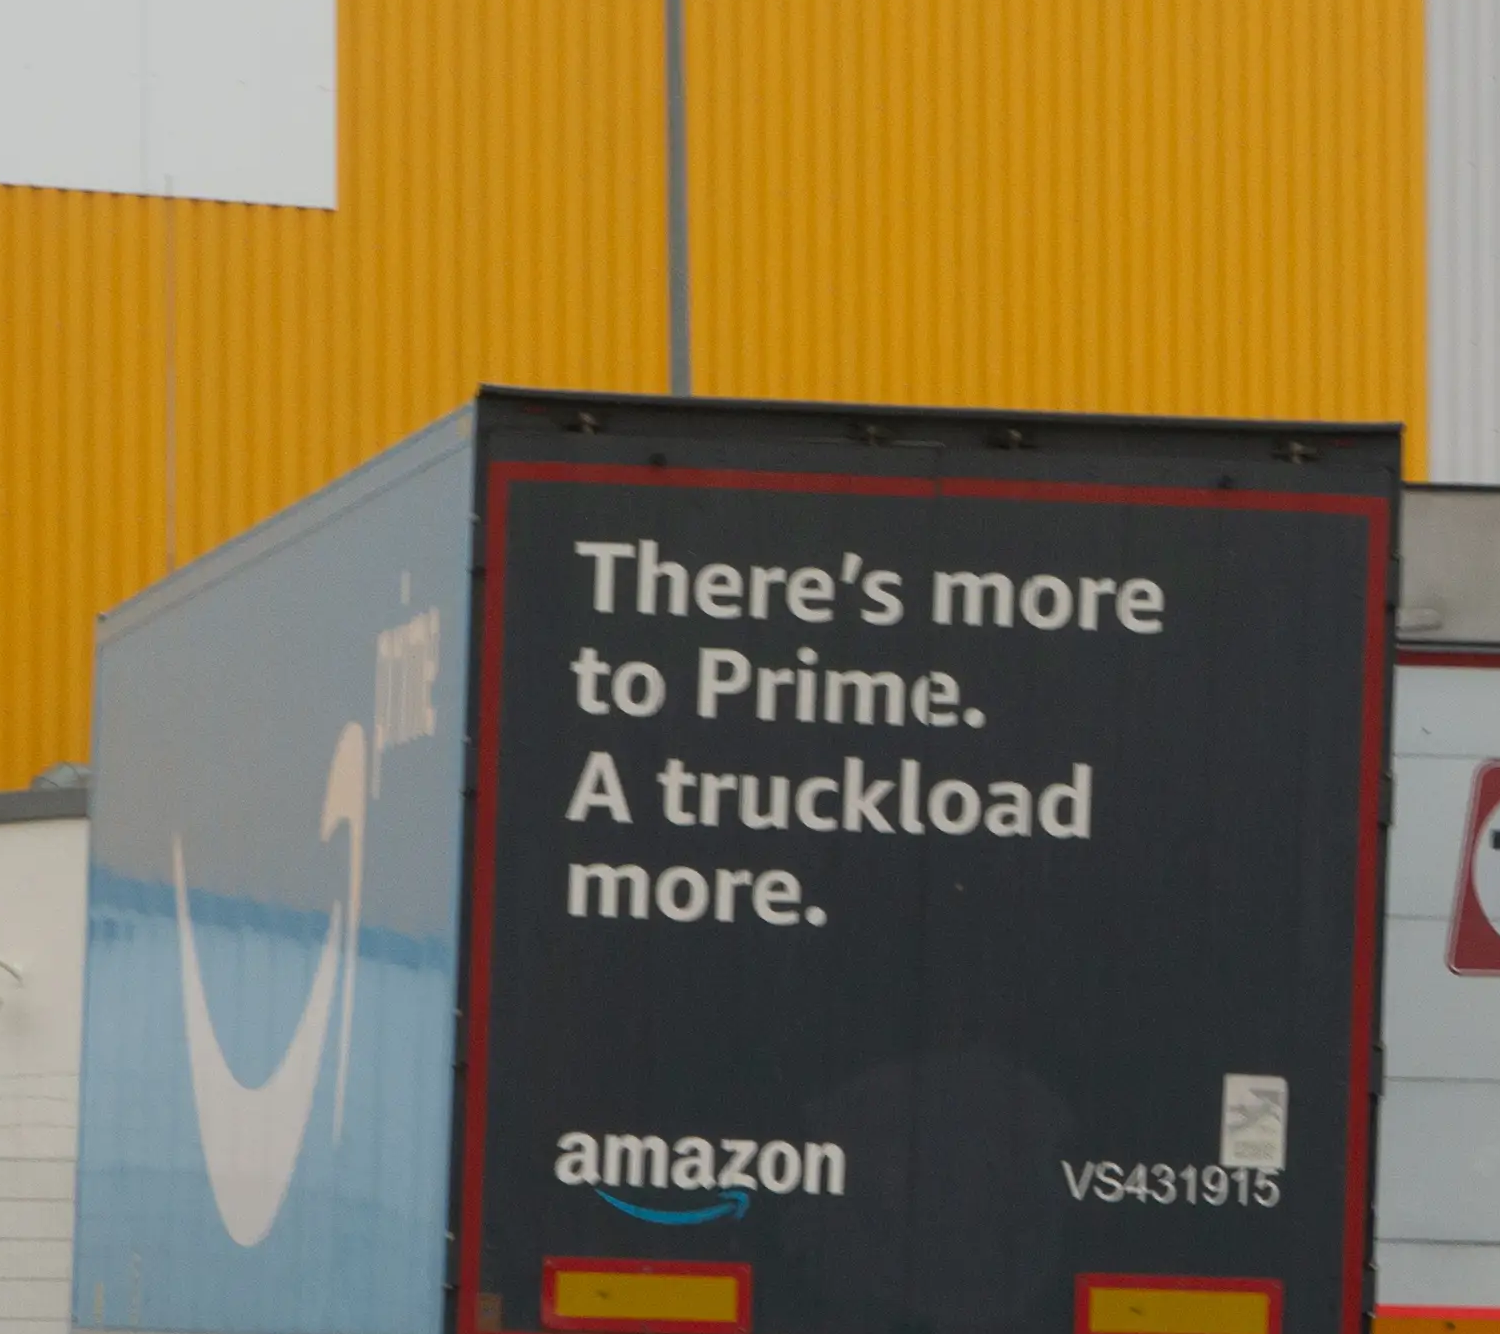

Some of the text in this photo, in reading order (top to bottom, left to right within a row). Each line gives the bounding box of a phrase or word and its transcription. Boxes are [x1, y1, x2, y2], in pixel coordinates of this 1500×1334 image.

[575, 538, 1165, 635] There's more
[570, 646, 987, 729] to Prime.
[566, 750, 1092, 839] A truckload
[567, 862, 828, 927] more.
[554, 1131, 846, 1196] amazon
[1060, 1159, 1282, 1208] VS431915
